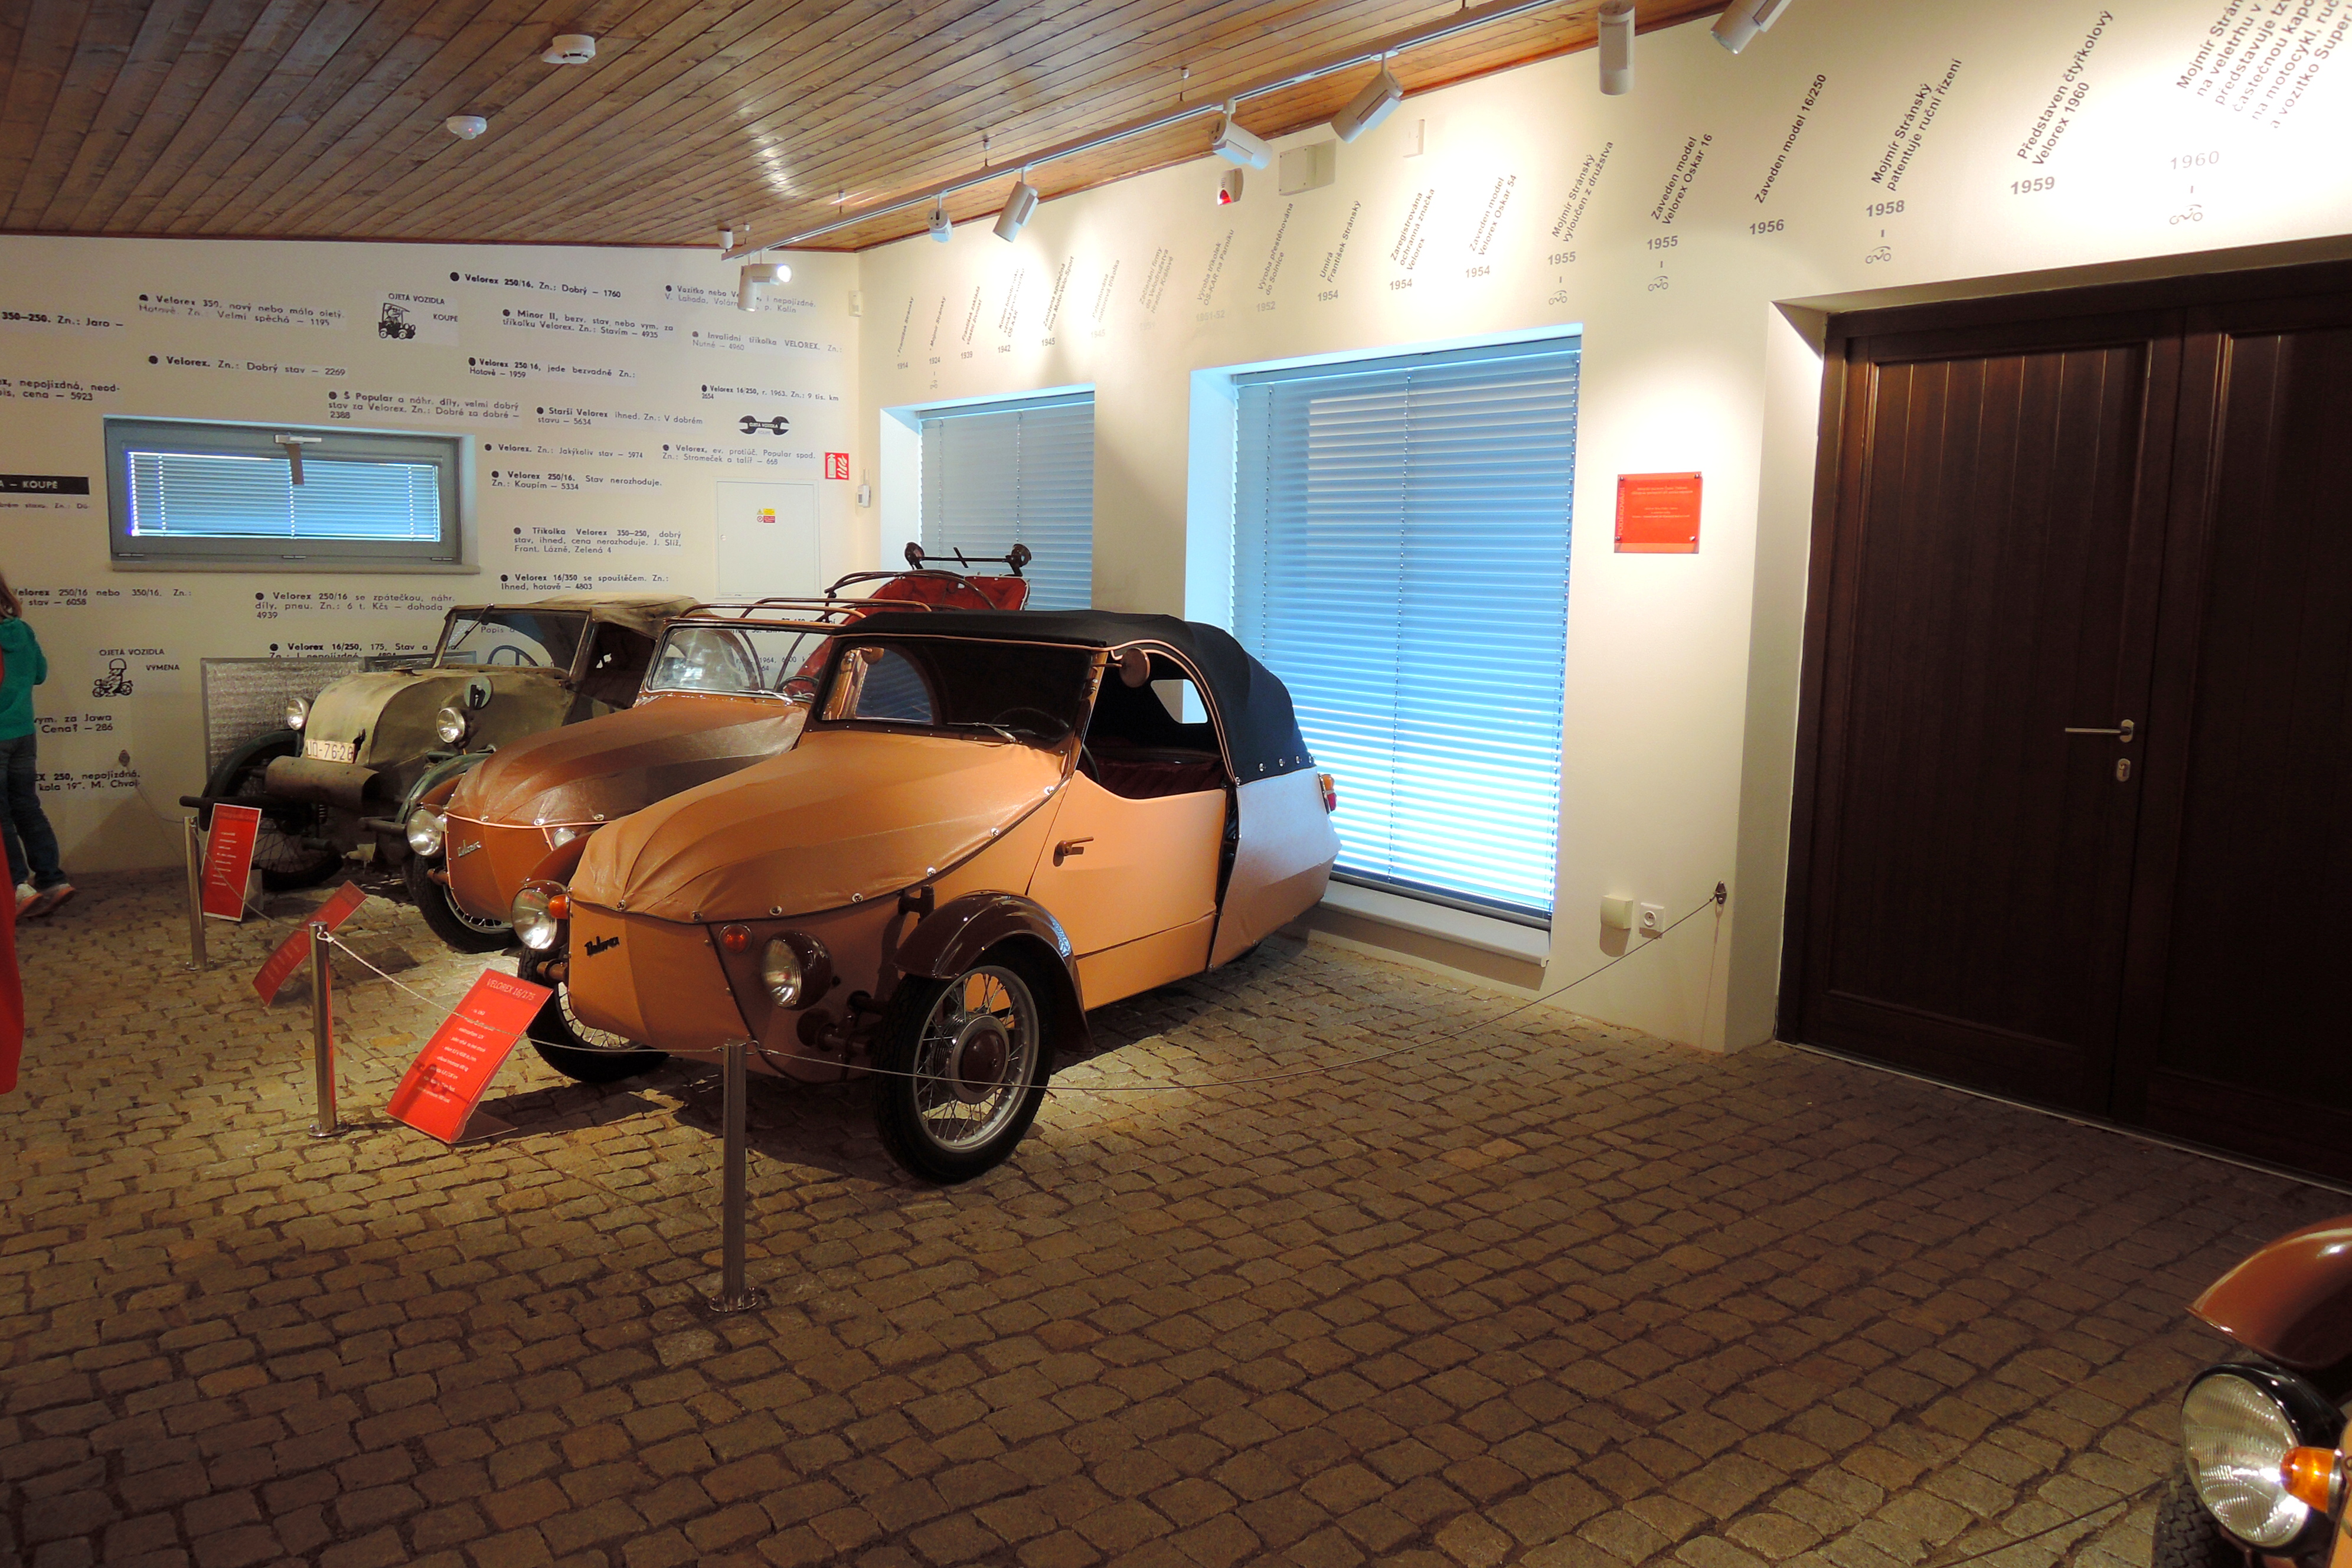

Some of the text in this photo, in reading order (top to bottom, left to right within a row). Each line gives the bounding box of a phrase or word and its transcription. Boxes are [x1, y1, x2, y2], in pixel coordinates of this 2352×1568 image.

[2197, 4, 2262, 96] na veletrhu v
[2176, 39, 2216, 89] Mojmír
[2216, 20, 2275, 105] představuje
[2270, 14, 2352, 129] a vozítko Super
[2017, 10, 2113, 159] Představen čtyřkolový
[2233, 38, 2288, 112] částečnou
[2252, 30, 2322, 120] na motocykl,
[1887, 58, 1962, 192] patentuje ruční řízení
[2032, 82, 2089, 164] Velorex 1960
[1755, 74, 1827, 204] Zaveden model 16/250
[1871, 83, 1932, 184] Mojmír Stránský
[2170, 151, 2220, 170] 1960
[1651, 136, 1697, 220] Zaveden model
[1662, 133, 1712, 225] Velorex Oskar 16
[2011, 177, 2055, 194] 1959
[1551, 154, 1595, 237] Mojmír Stránský
[1563, 197, 1588, 243] vyloučen
[1589, 142, 1613, 187] družstva
[1419, 188, 1435, 221] značka
[1469, 177, 1504, 251] Zaveden model
[1866, 200, 1905, 217] 1958
[1478, 175, 1517, 256] Velorex Oskar 54
[1390, 192, 1422, 260] Zaregistrována
[1749, 219, 1785, 234] 1956
[1327, 201, 1361, 283] František Stránský
[1647, 236, 1678, 250] 1955
[1407, 238, 1425, 270] Velorex
[1548, 251, 1576, 265] 1955
[1217, 262, 1223, 272] na
[1266, 252, 1284, 295] do Solnice
[1466, 266, 1490, 278] 1954
[465, 274, 498, 284] Velorex
[540, 282, 556, 290] Zn.:
[562, 284, 587, 295] Dobrý
[1390, 279, 1412, 290] 1954
[1146, 299, 1151, 309] do
[1151, 288, 1163, 313] Hradec
[1318, 290, 1338, 301] 1954
[1256, 301, 1275, 312] 1952
[86, 318, 110, 327] Jaro
[601, 326, 628, 335] Stavím
[1048, 313, 1056, 331] firma
[998, 345, 1011, 353] 1942
[1042, 338, 1056, 346] 1945
[479, 358, 508, 367] Velorex
[961, 351, 973, 359] 1939
[218, 360, 239, 368] Zn.:
[247, 362, 277, 373] Dobrý
[576, 409, 607, 417] Velorex
[515, 481, 547, 489] Koupím
[610, 478, 661, 487] nerozhoduje.
[659, 531, 681, 539] dobrý
[42, 723, 113, 733] Cena? 286
